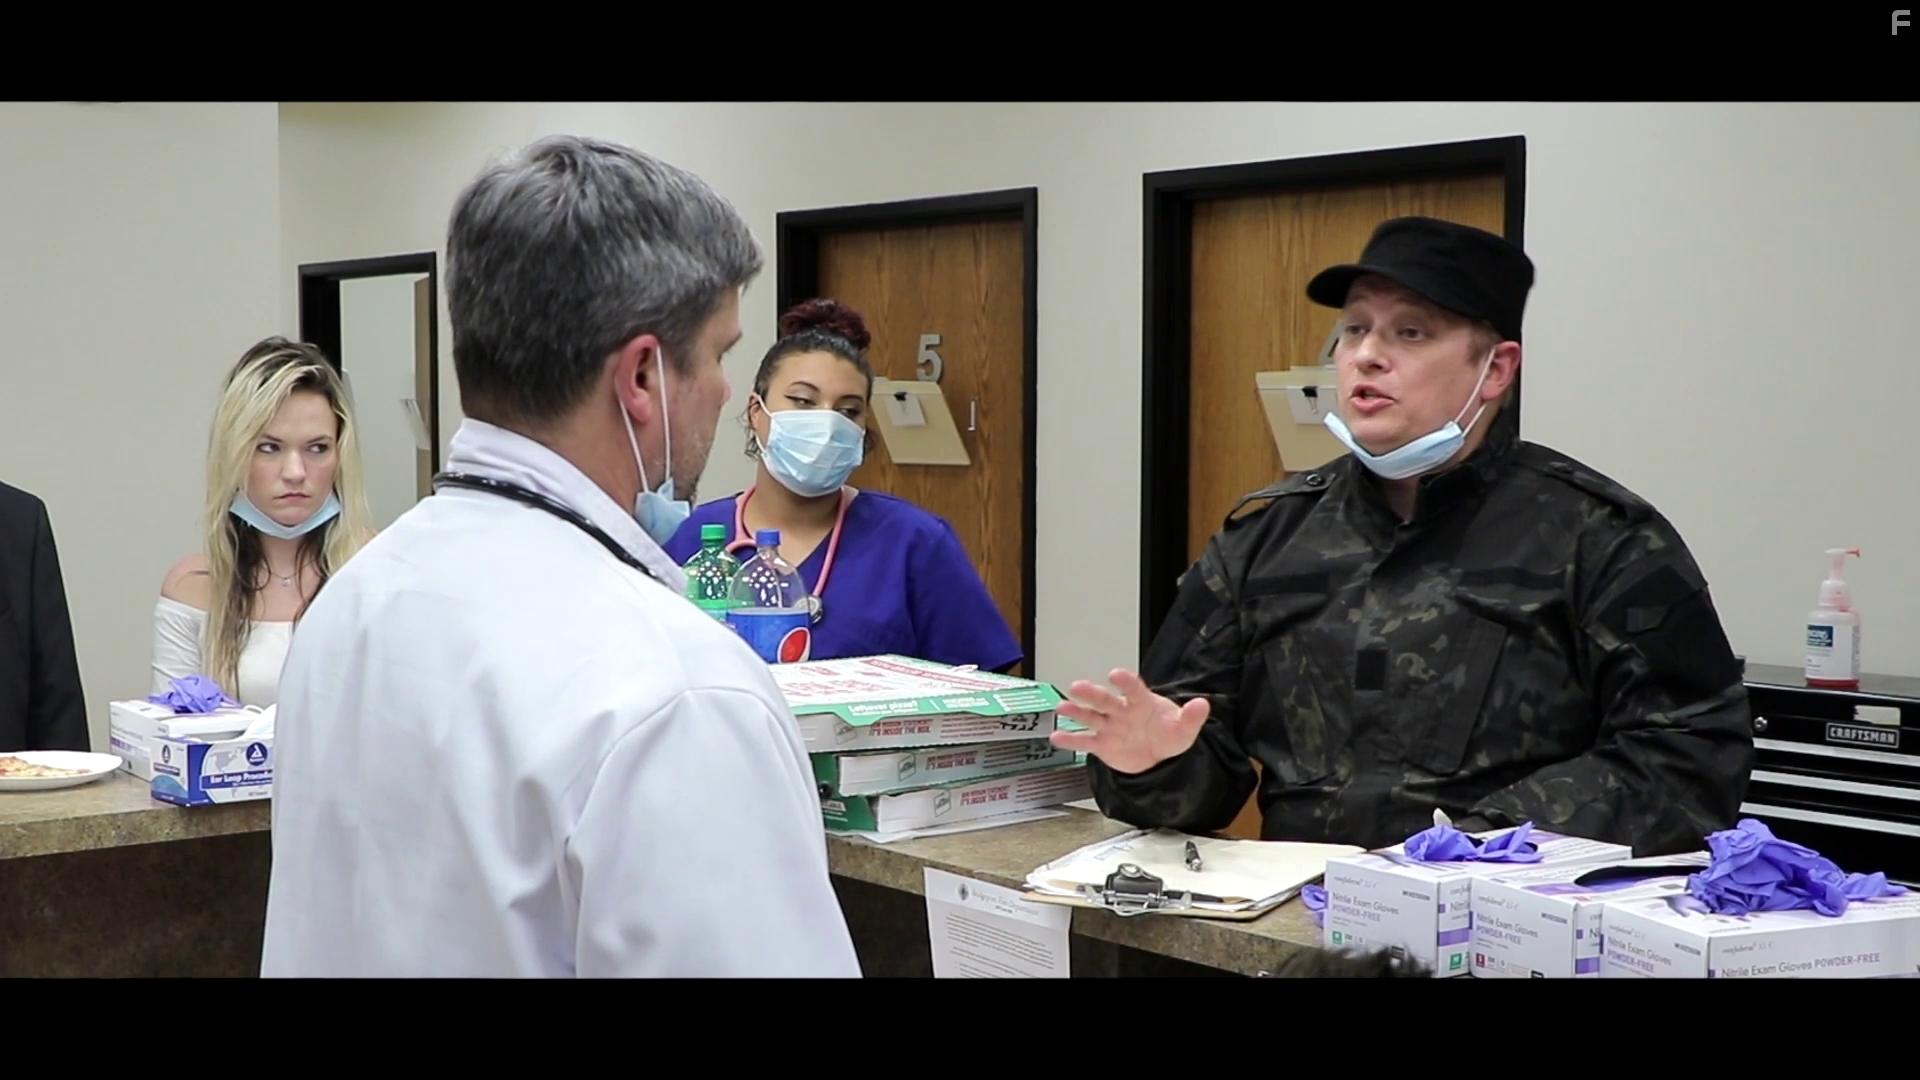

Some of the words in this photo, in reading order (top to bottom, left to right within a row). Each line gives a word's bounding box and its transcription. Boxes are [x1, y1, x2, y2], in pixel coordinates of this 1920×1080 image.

[916, 334, 943, 382] 5
[1830, 726, 1895, 745] CRAFTSMAN
[1333, 891, 1352, 904] Nitrile
[1353, 896, 1372, 908] Exam
[1373, 901, 1399, 915] Gloves
[1333, 903, 1381, 921] POWDER-FREE
[1496, 917, 1514, 930] Exam
[1515, 923, 1539, 938] Gloves
[1628, 942, 1646, 955] Exam
[1647, 948, 1672, 966] Gloves
[1722, 966, 1750, 978] Nitrile
[1751, 964, 1777, 976] Exam
[1778, 961, 1813, 973] Gloves
[1814, 952, 1881, 968] POWDER-FREE
